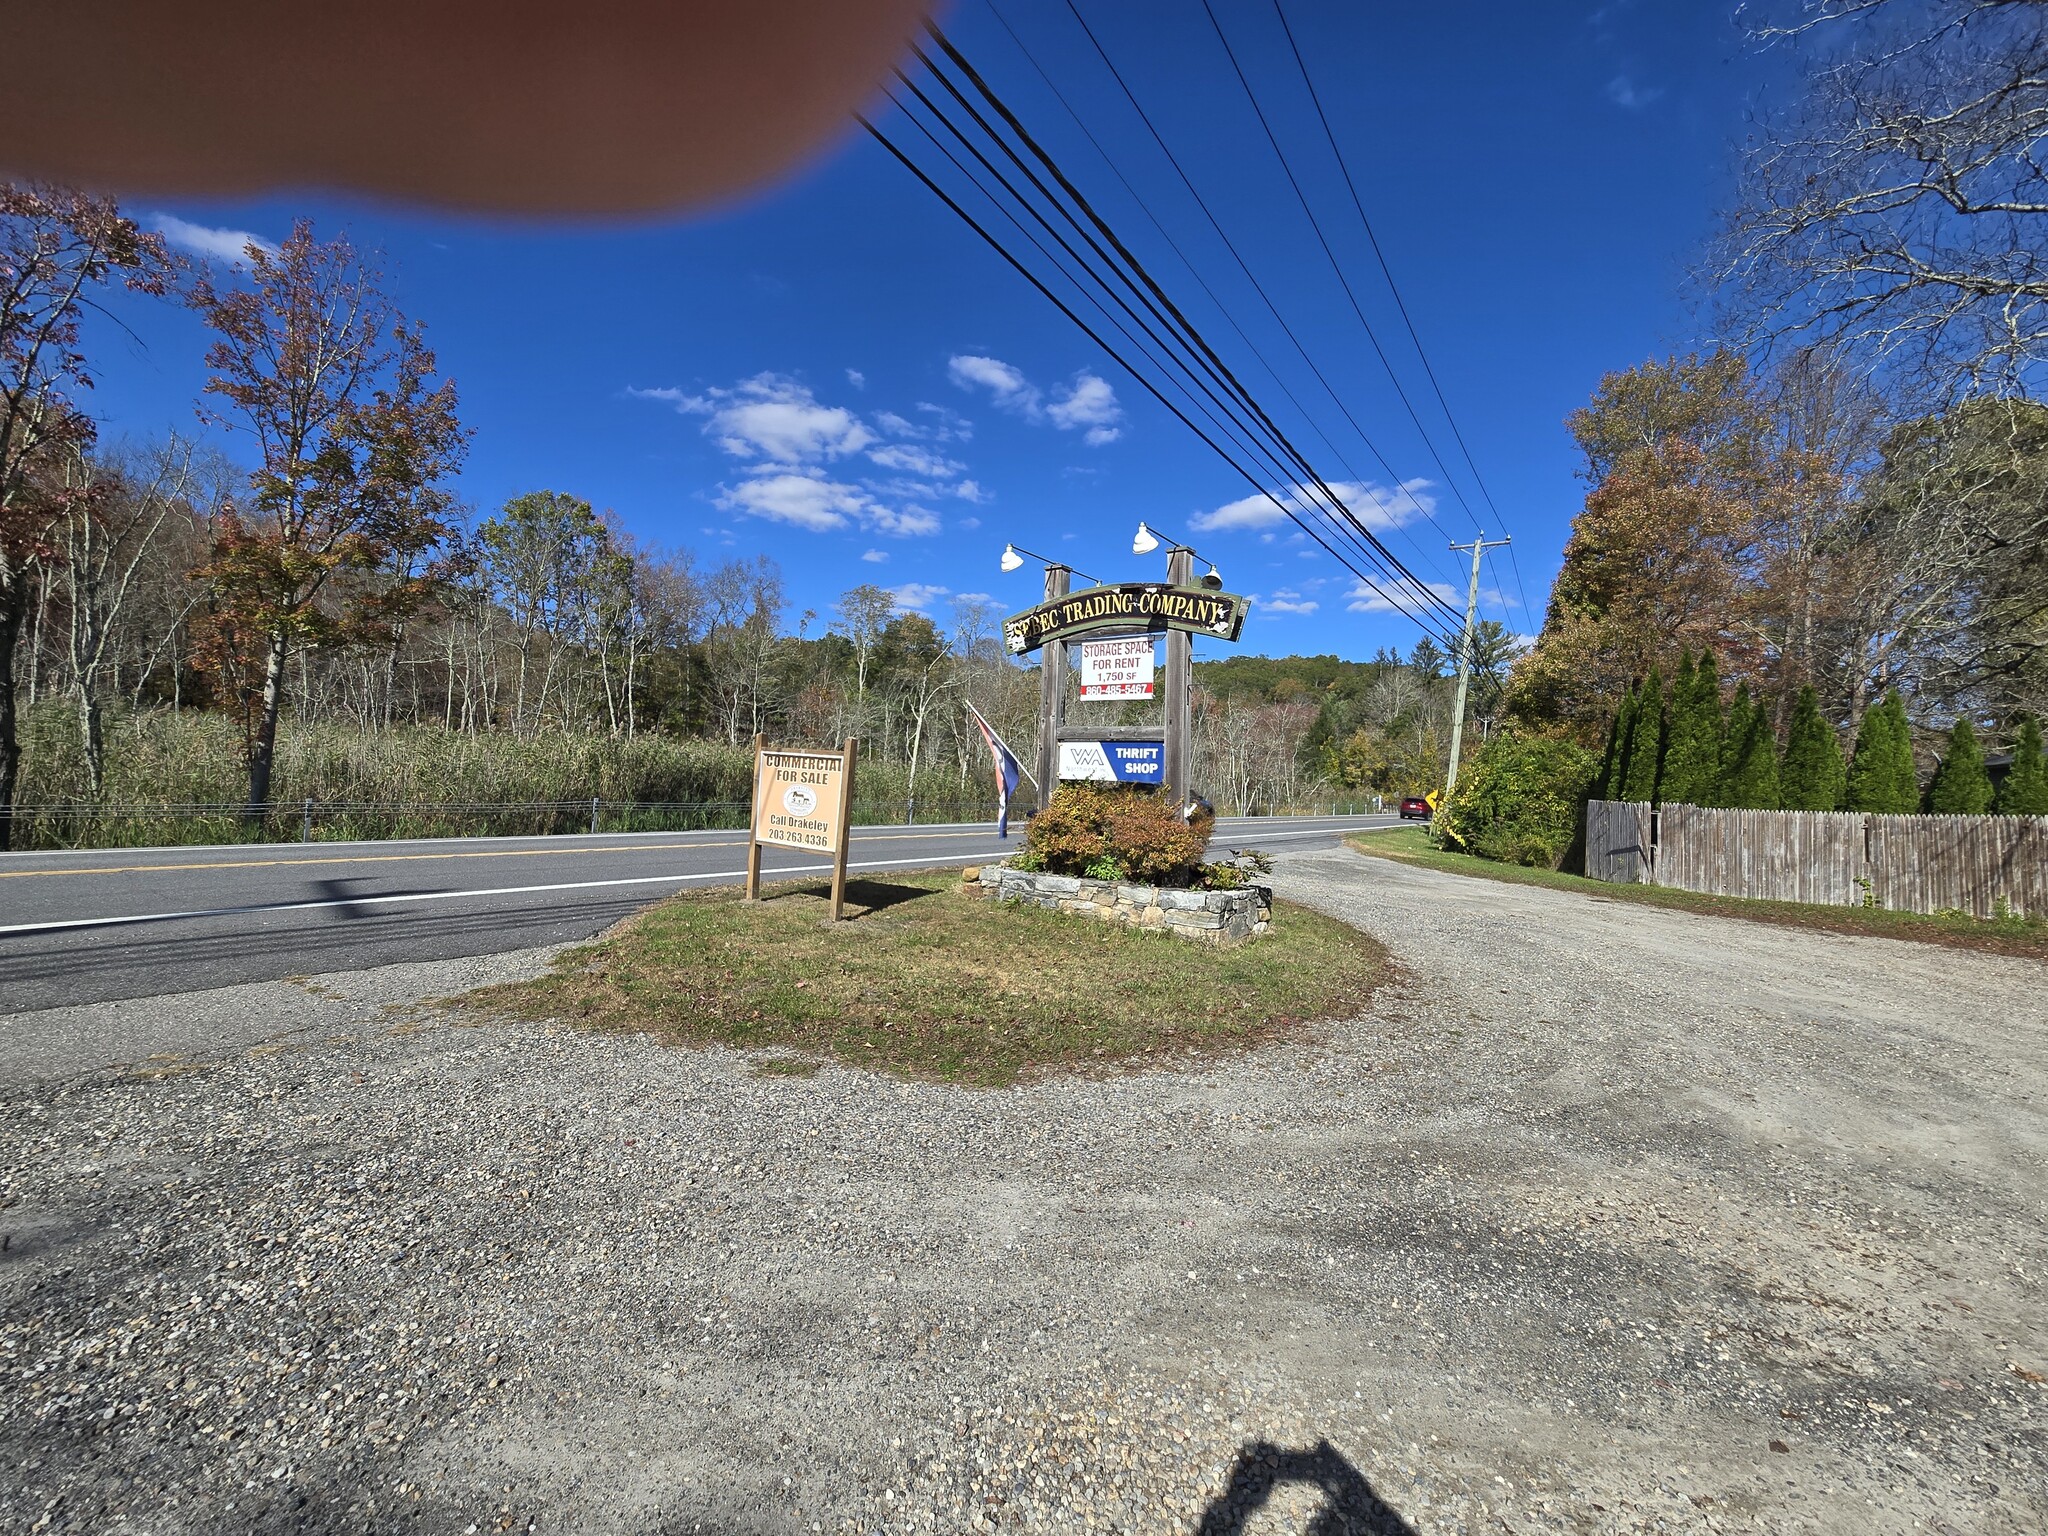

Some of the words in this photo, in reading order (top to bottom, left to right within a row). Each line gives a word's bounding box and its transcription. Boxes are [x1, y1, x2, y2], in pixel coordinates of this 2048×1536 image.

[1063, 593, 1133, 624] TRADING
[1139, 593, 1223, 624] COMPANY
[1084, 643, 1122, 658] STORAGE
[1125, 641, 1153, 655] SPACE
[1093, 659, 1112, 670] FOR
[1114, 657, 1141, 669] RENT
[1097, 671, 1124, 682] 1,750
[1126, 672, 1137, 680] SF
[1086, 684, 1147, 695] 860-485-5467
[1115, 748, 1159, 759] THRIFT
[1125, 763, 1159, 774] SHOP
[777, 770, 797, 782] FOR
[800, 771, 829, 785] SALE
[770, 814, 787, 826] Call
[788, 817, 829, 833] Drakeley
[769, 828, 828, 847] 203.263.4336
